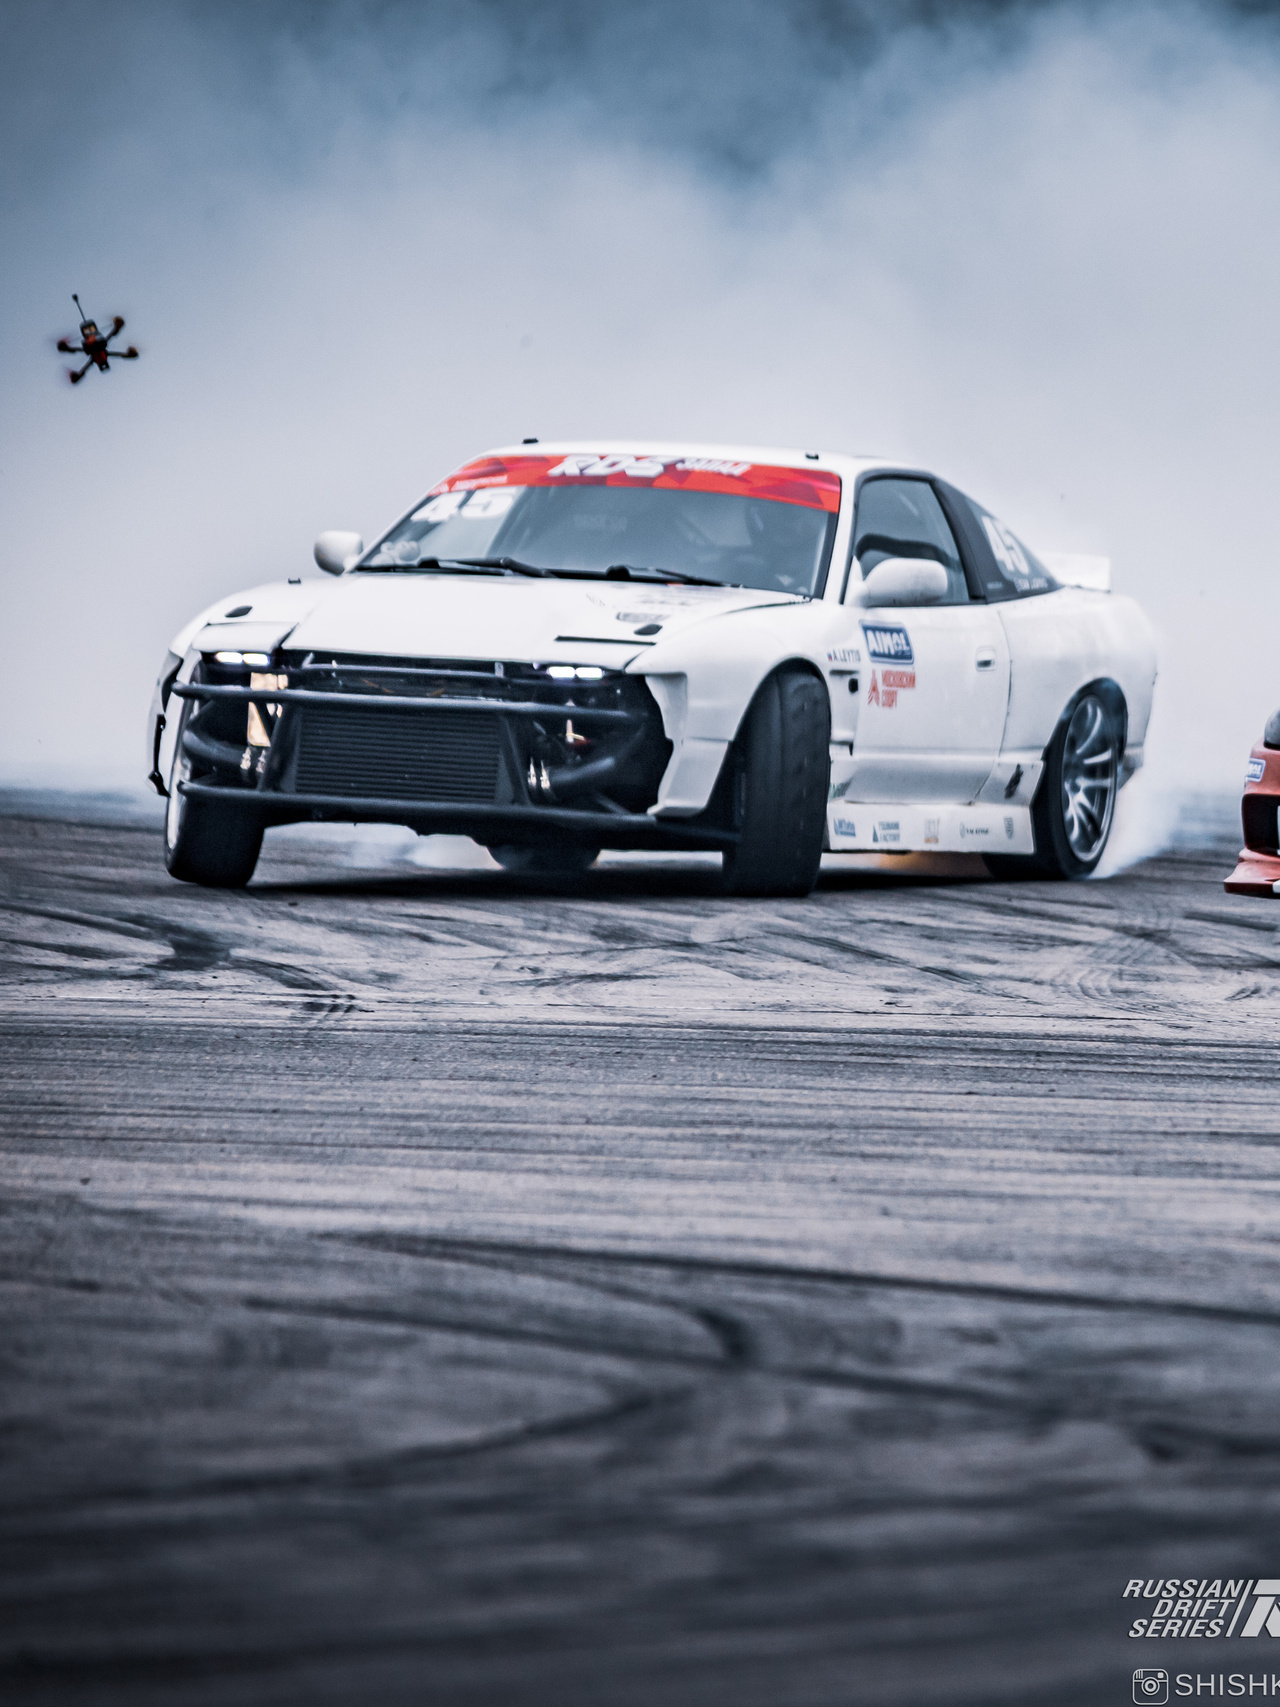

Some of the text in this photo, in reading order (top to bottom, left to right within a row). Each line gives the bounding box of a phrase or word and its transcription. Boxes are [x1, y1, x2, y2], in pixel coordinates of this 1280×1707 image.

[547, 455, 684, 477] RDS
[410, 486, 511, 522] 45
[867, 630, 911, 656] AIMOL
